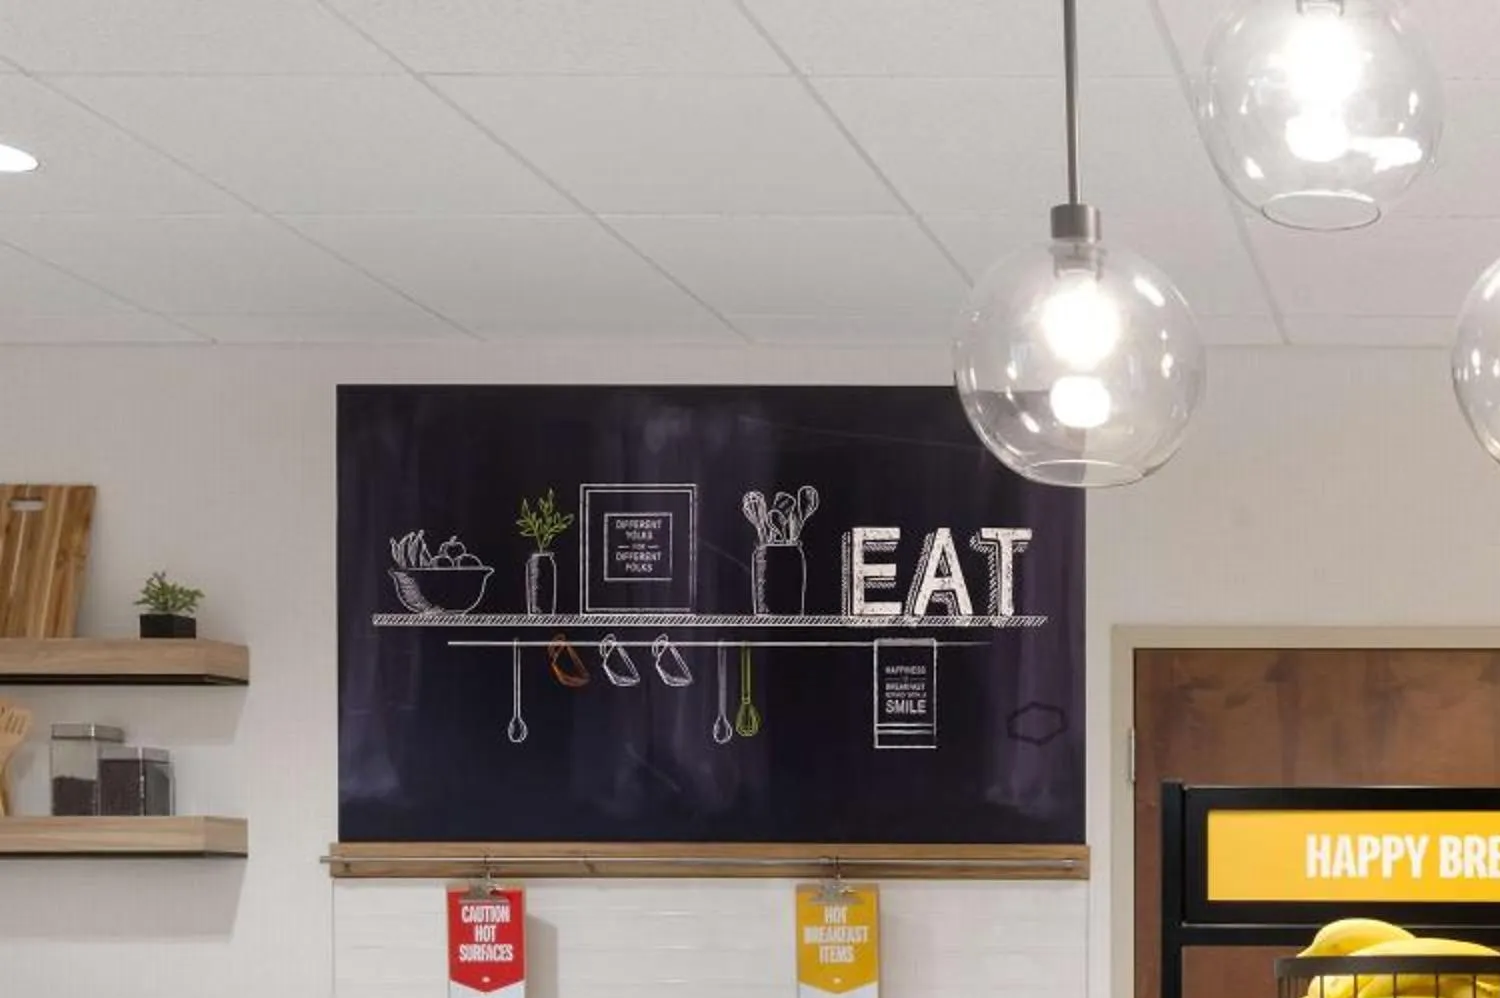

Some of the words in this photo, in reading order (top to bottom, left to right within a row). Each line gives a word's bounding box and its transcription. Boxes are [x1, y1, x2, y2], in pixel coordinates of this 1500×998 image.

[841, 527, 1032, 615] EAT
[885, 699, 927, 714] SMILE
[1306, 834, 1430, 879] HAPPY
[461, 904, 511, 923] CAUTION
[825, 905, 847, 923] HOT
[475, 924, 497, 942] HOT
[803, 925, 869, 944] BREAKFAST
[459, 943, 514, 961] SURFACES
[819, 945, 855, 963] ITEMS
